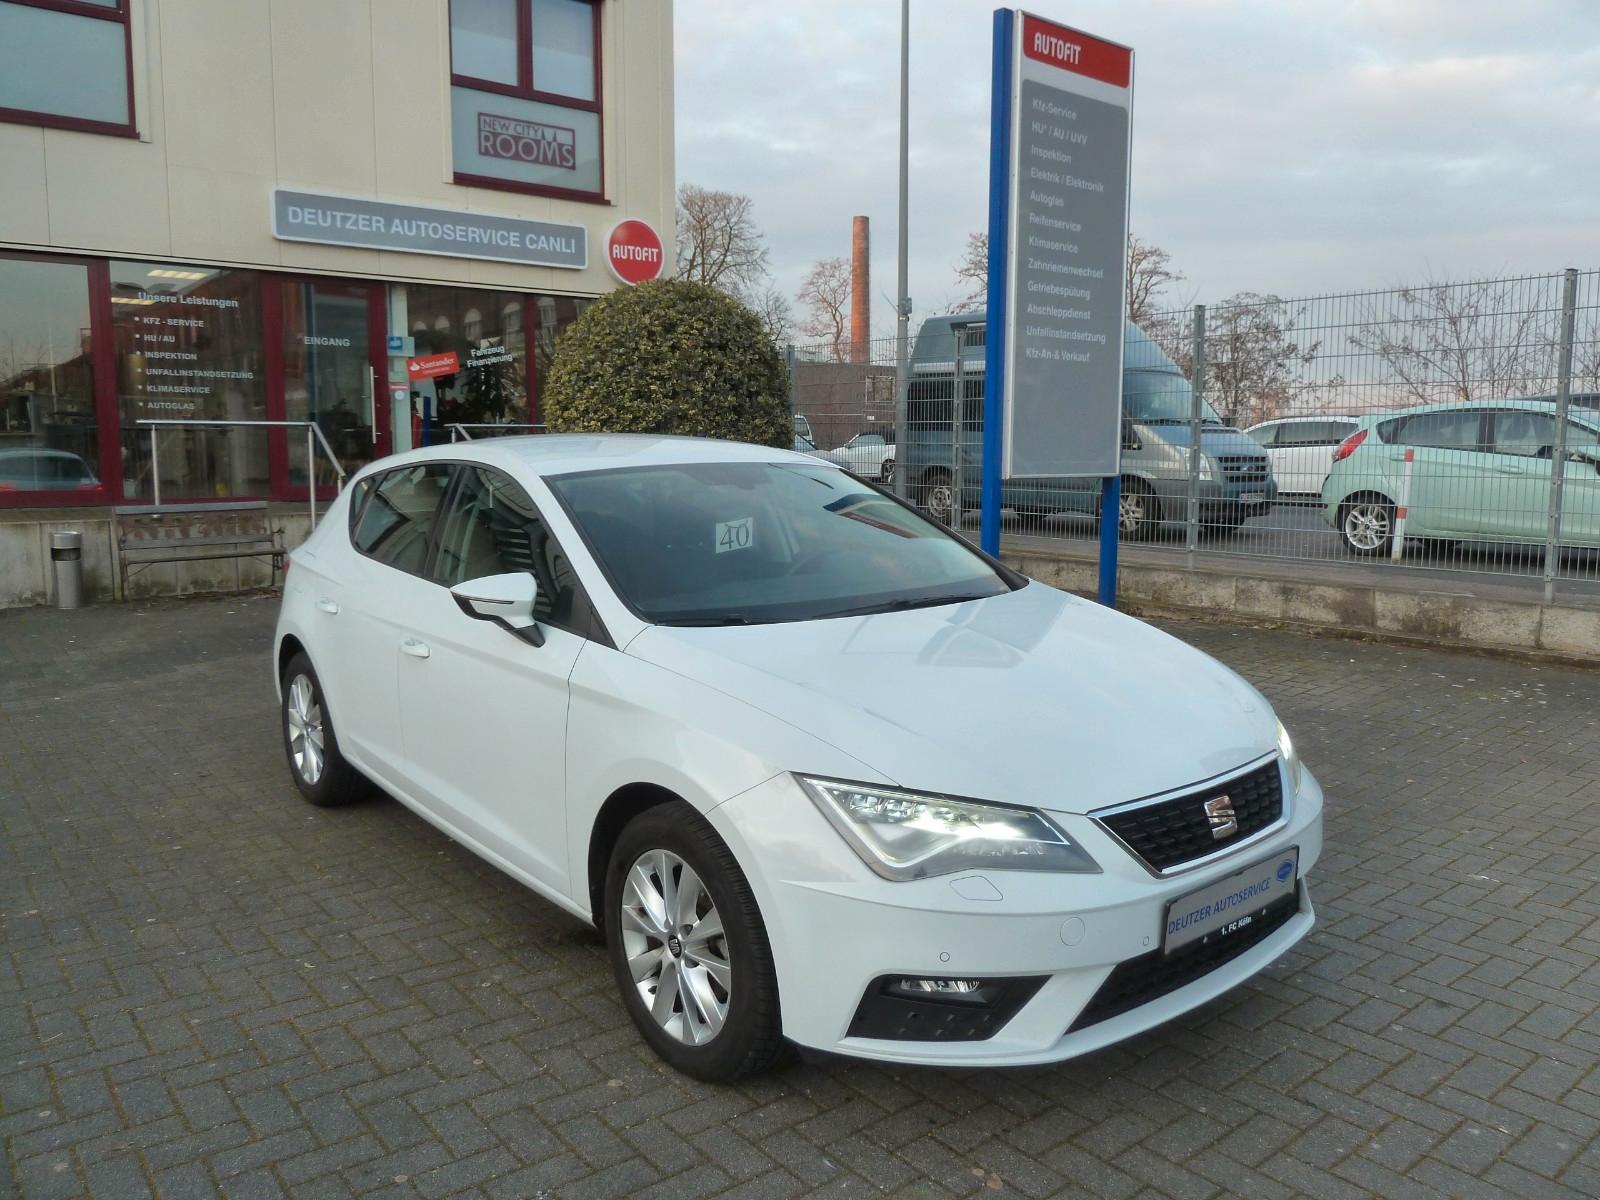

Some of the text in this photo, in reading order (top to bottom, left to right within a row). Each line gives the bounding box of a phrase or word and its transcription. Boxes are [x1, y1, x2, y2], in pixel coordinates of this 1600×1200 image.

[1034, 32, 1081, 64] AUTOFIT
[1032, 96, 1077, 120] Kfz-Service
[483, 118, 540, 138] NEW CITY
[1053, 127, 1065, 140] AU
[1070, 132, 1088, 145] UVV
[480, 131, 574, 167] ROOMS
[1032, 144, 1072, 164] Inspektion
[1031, 167, 1060, 184] Elektrik
[1066, 176, 1104, 192] Elektronik
[1030, 190, 1064, 208] Autoglas
[288, 206, 576, 254] DEUTZER AUTOSERVICE CANLI
[1030, 212, 1082, 232] Reifenservice
[613, 244, 658, 262] AUTOFIT
[1029, 234, 1078, 254] Klimaservice
[1028, 258, 1104, 278] Zahnriemenwechsel
[138, 292, 239, 308] Unsere Leistungen
[1027, 303, 1091, 320] Abschleppdienst
[144, 317, 160, 326] KFZ
[168, 318, 204, 328] SERVICE
[164, 335, 176, 343] AU
[304, 336, 351, 347] EINGANG
[1026, 325, 1106, 344] Unfallinstandsetzung
[144, 351, 198, 360] INSPEKTION
[466, 353, 513, 368] Finanzierung
[470, 345, 505, 358] Fahrzeug
[1062, 350, 1090, 362] Verkauf
[421, 356, 455, 370] Santander
[146, 368, 254, 380] UNFALLINSTANDSETZUNG
[146, 385, 210, 394] KLIMASERVICE
[148, 402, 194, 410] AUTOGLAS
[720, 524, 750, 550] 40
[1168, 877, 1271, 935] DEUTZER AUTOSERVICE
[1221, 916, 1252, 936] 1. FC Köln
